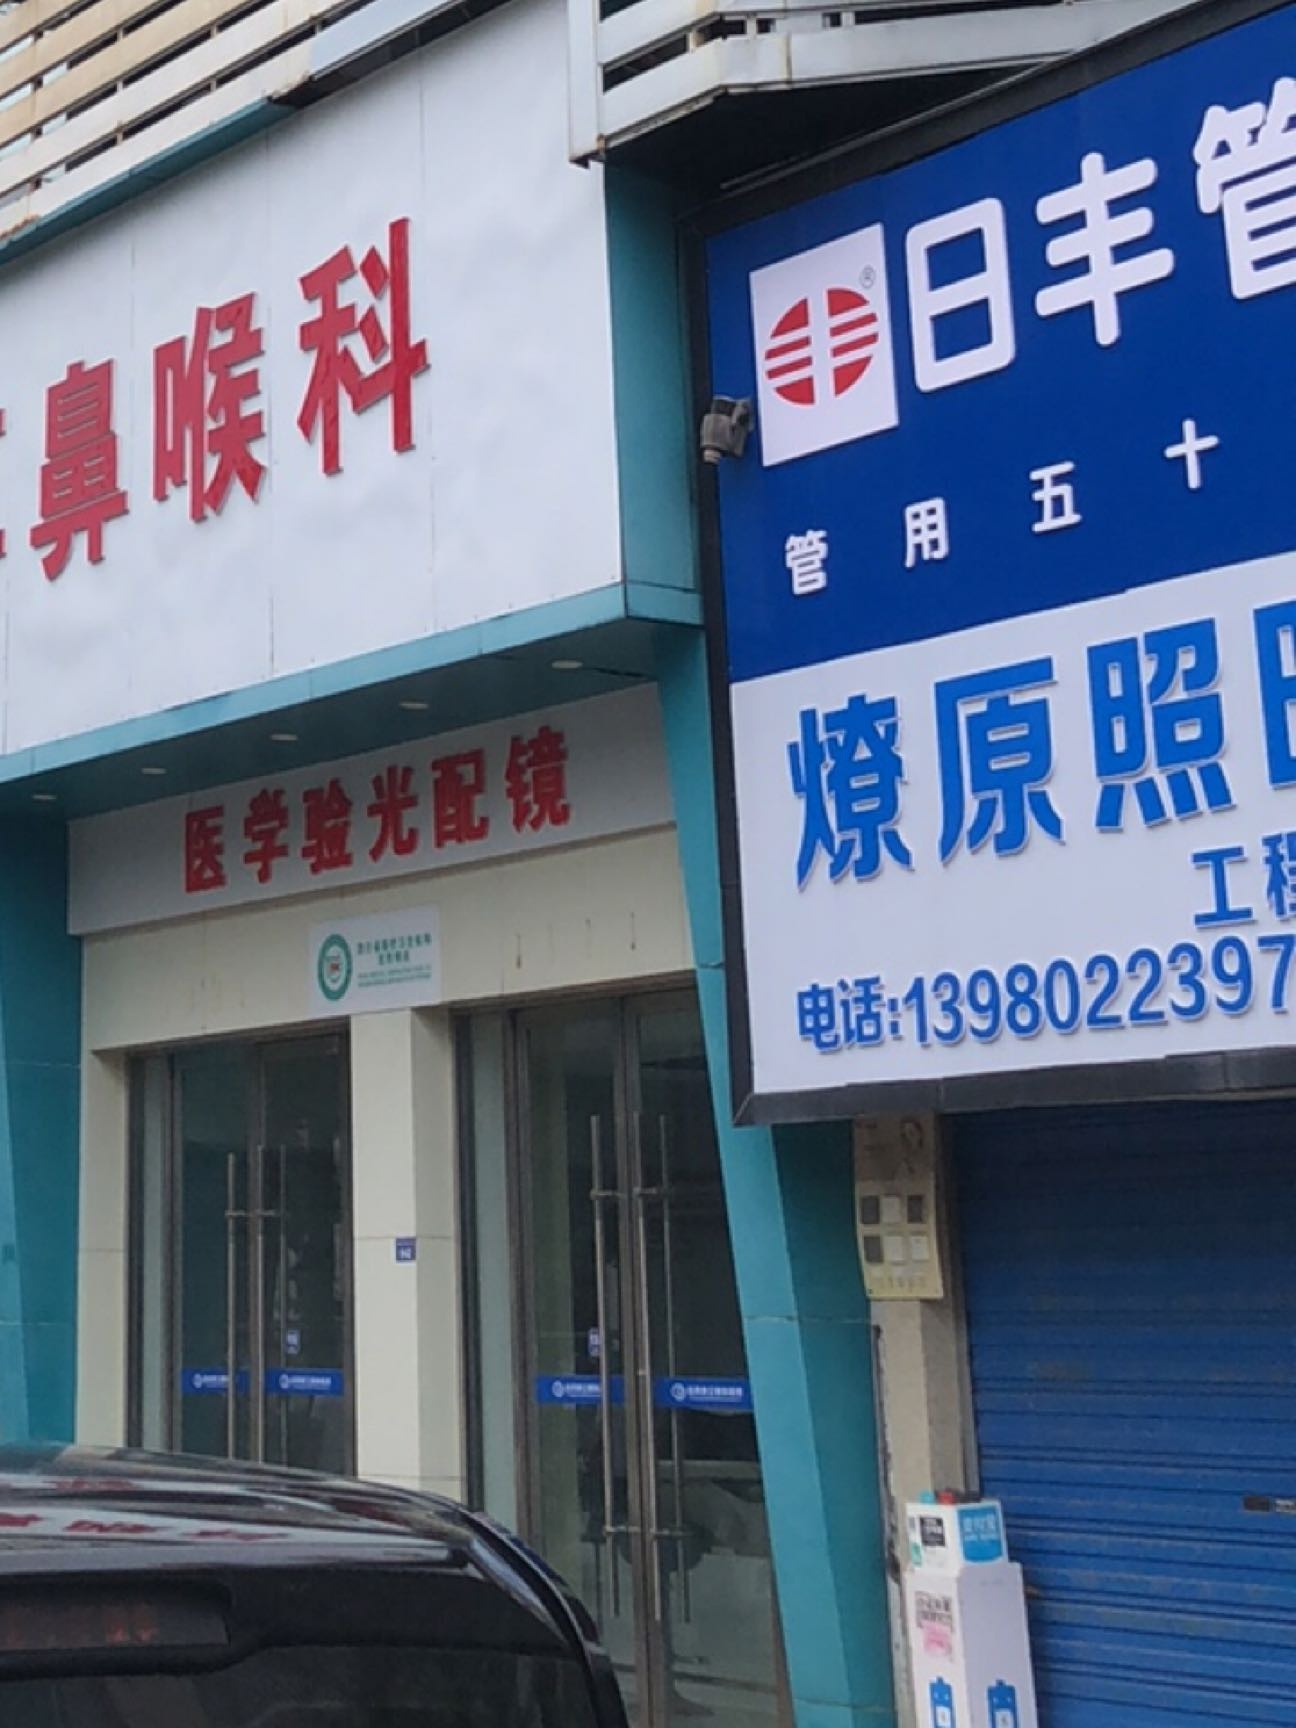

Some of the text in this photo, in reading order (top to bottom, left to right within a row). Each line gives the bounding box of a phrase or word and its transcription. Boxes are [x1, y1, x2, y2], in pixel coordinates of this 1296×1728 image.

[183, 725, 570, 894] 医学验光配镜
